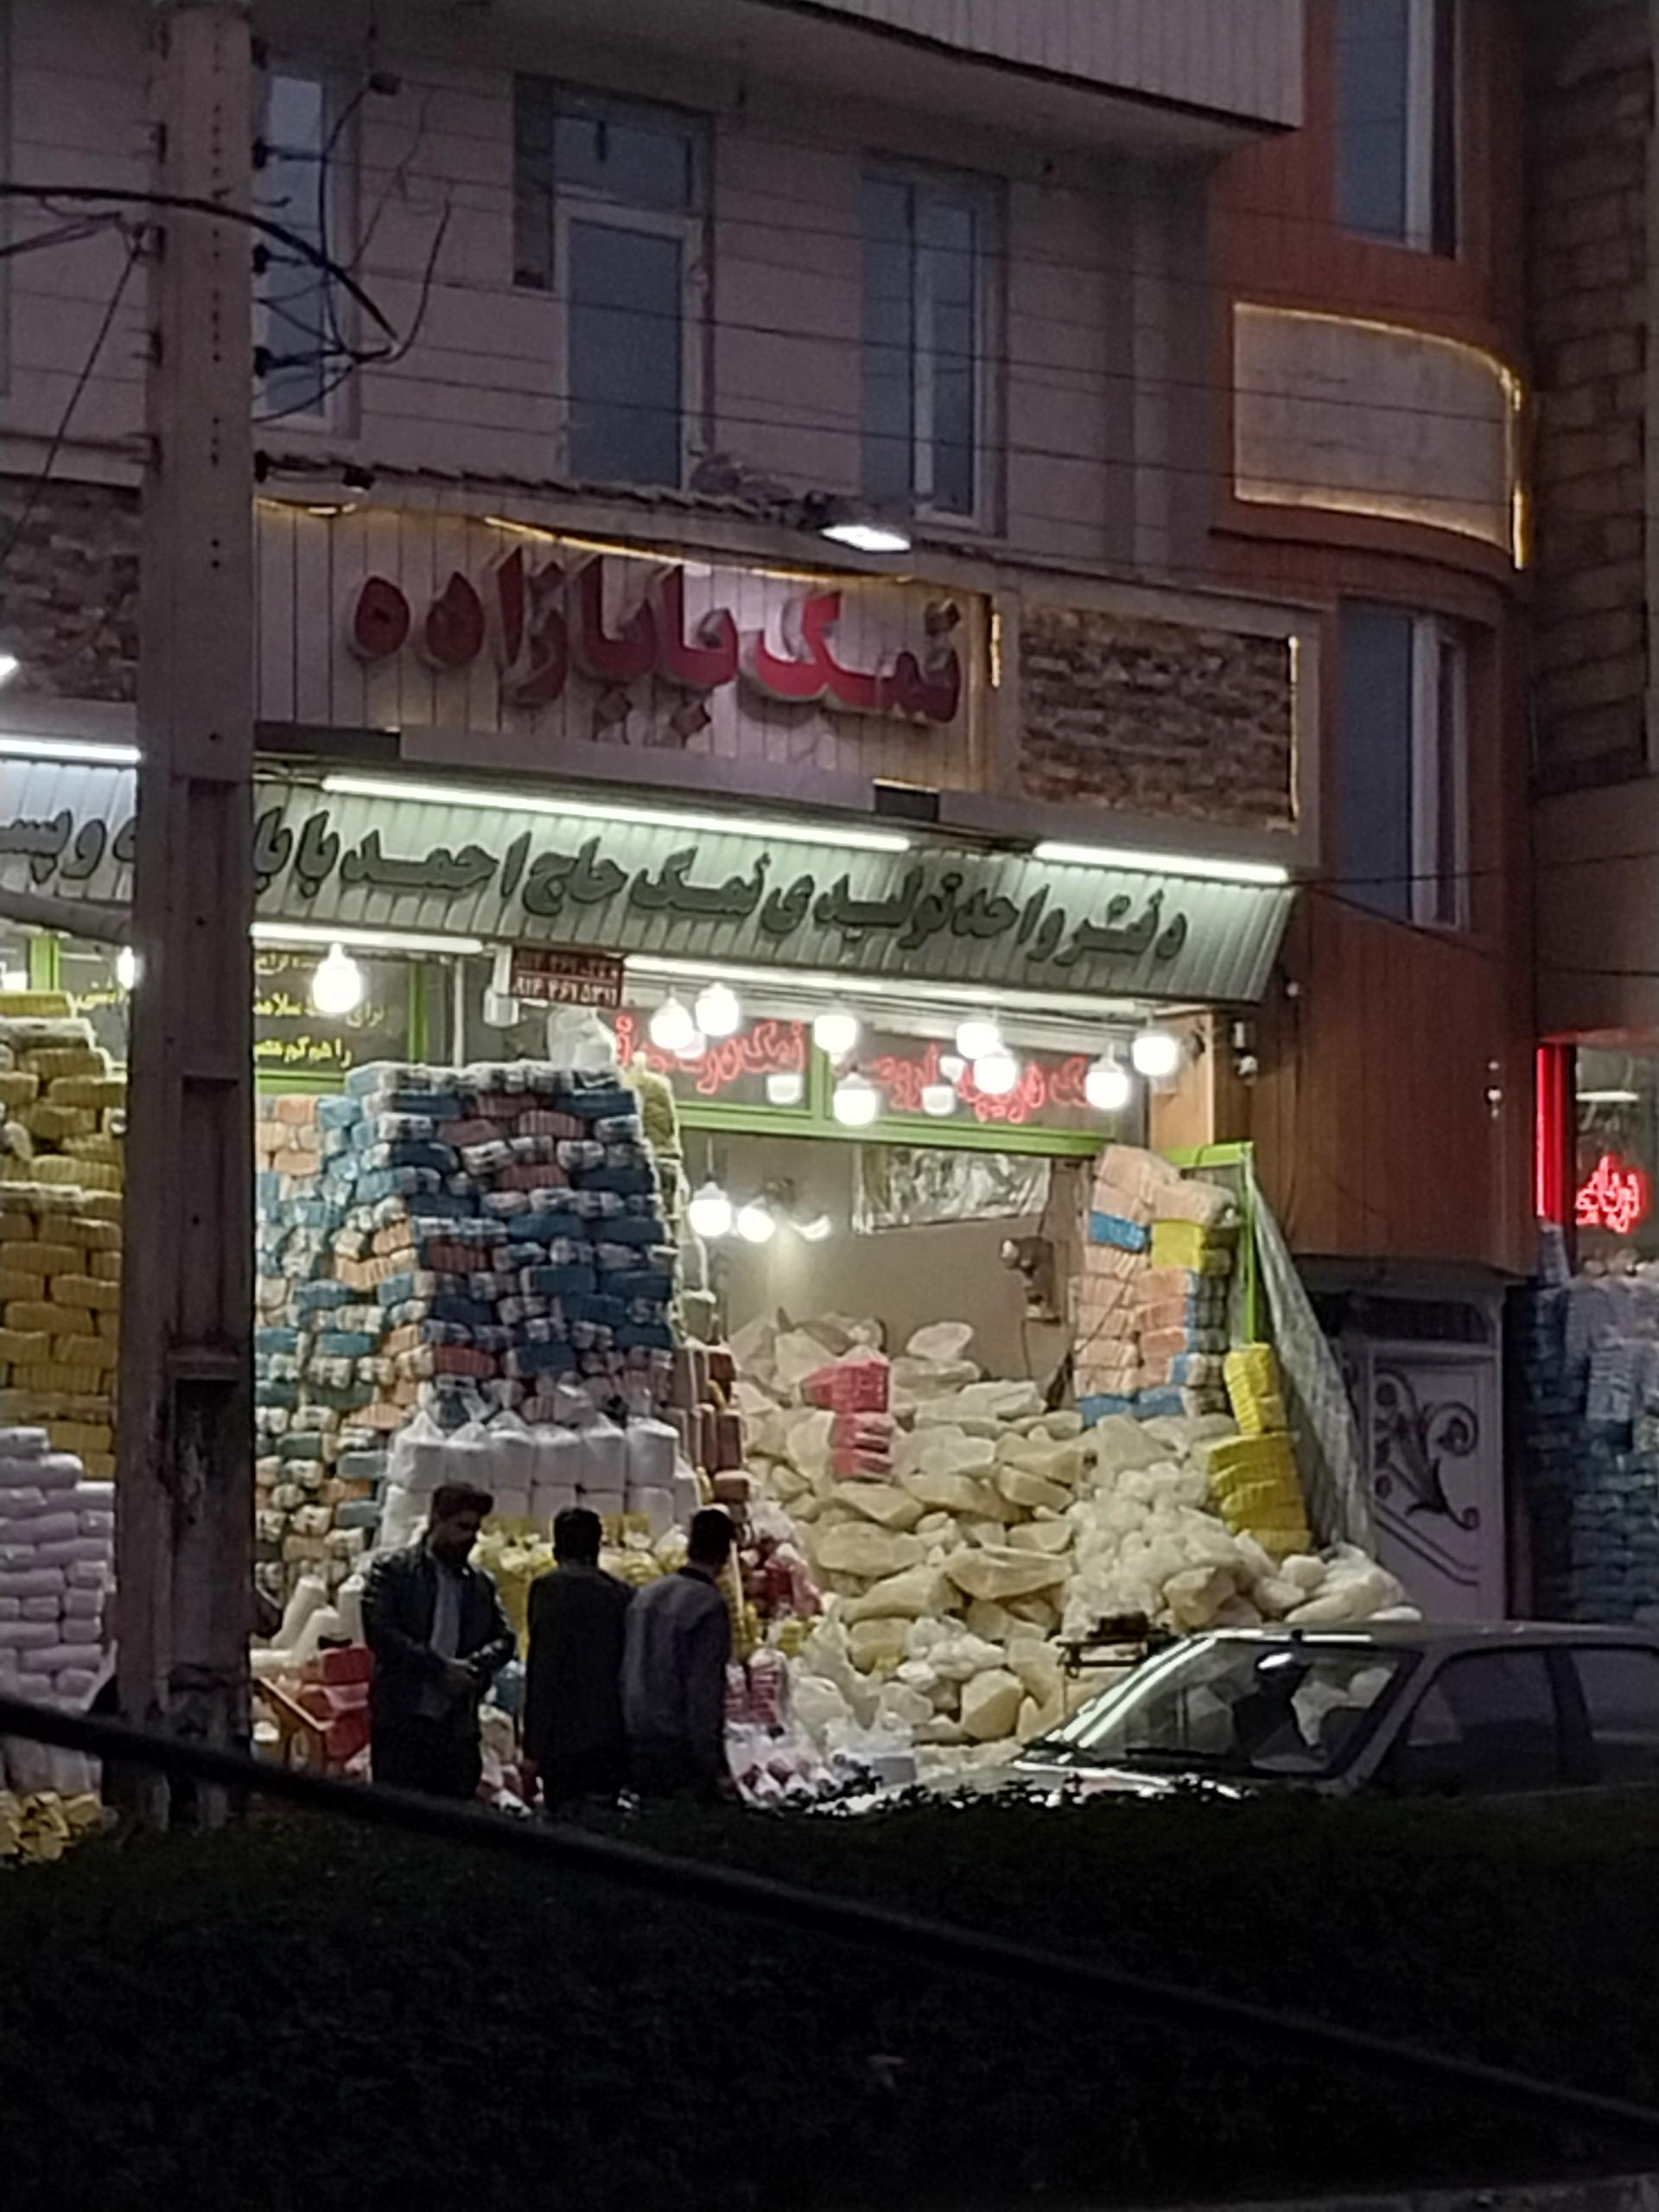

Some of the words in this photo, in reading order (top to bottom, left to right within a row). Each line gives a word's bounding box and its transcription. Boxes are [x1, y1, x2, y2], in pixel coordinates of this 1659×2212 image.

[60, 818, 107, 880] و
[340, 830, 532, 891] احمد
[523, 836, 629, 917] حاج
[629, 846, 772, 917] نمک
[761, 864, 964, 950] تولیدی
[951, 884, 1066, 962] واحد
[1053, 889, 1188, 967] دفتر
